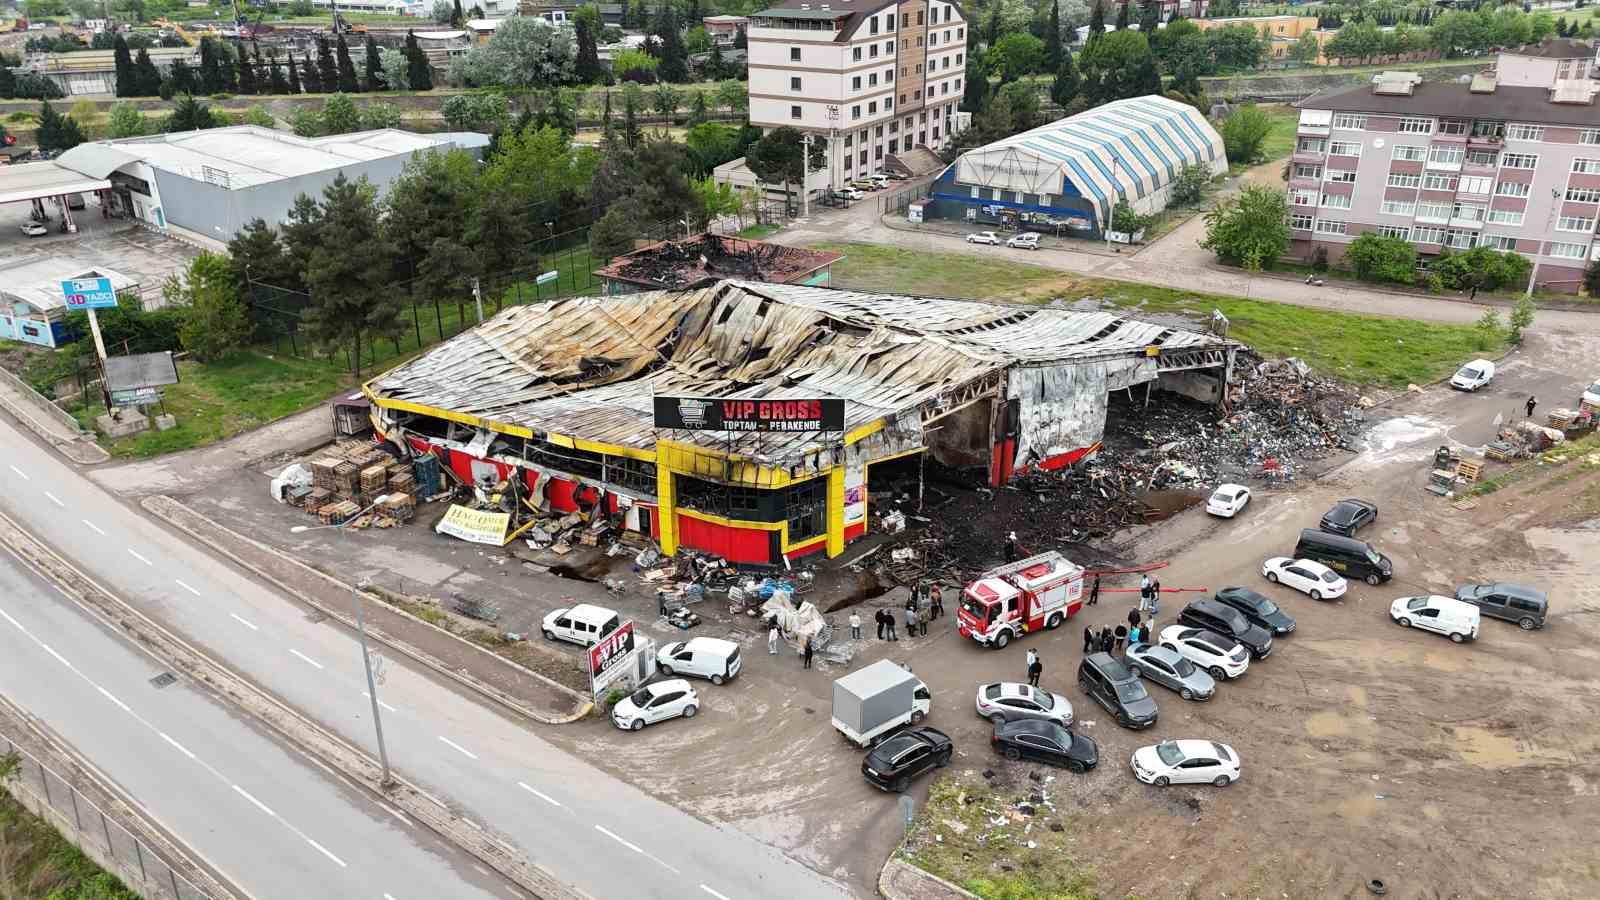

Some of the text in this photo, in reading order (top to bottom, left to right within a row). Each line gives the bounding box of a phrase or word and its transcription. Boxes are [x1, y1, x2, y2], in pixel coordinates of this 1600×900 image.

[723, 400, 822, 419] VIP GROSS
[723, 421, 757, 430] TOPTAN
[770, 421, 822, 430] PERAKENDE
